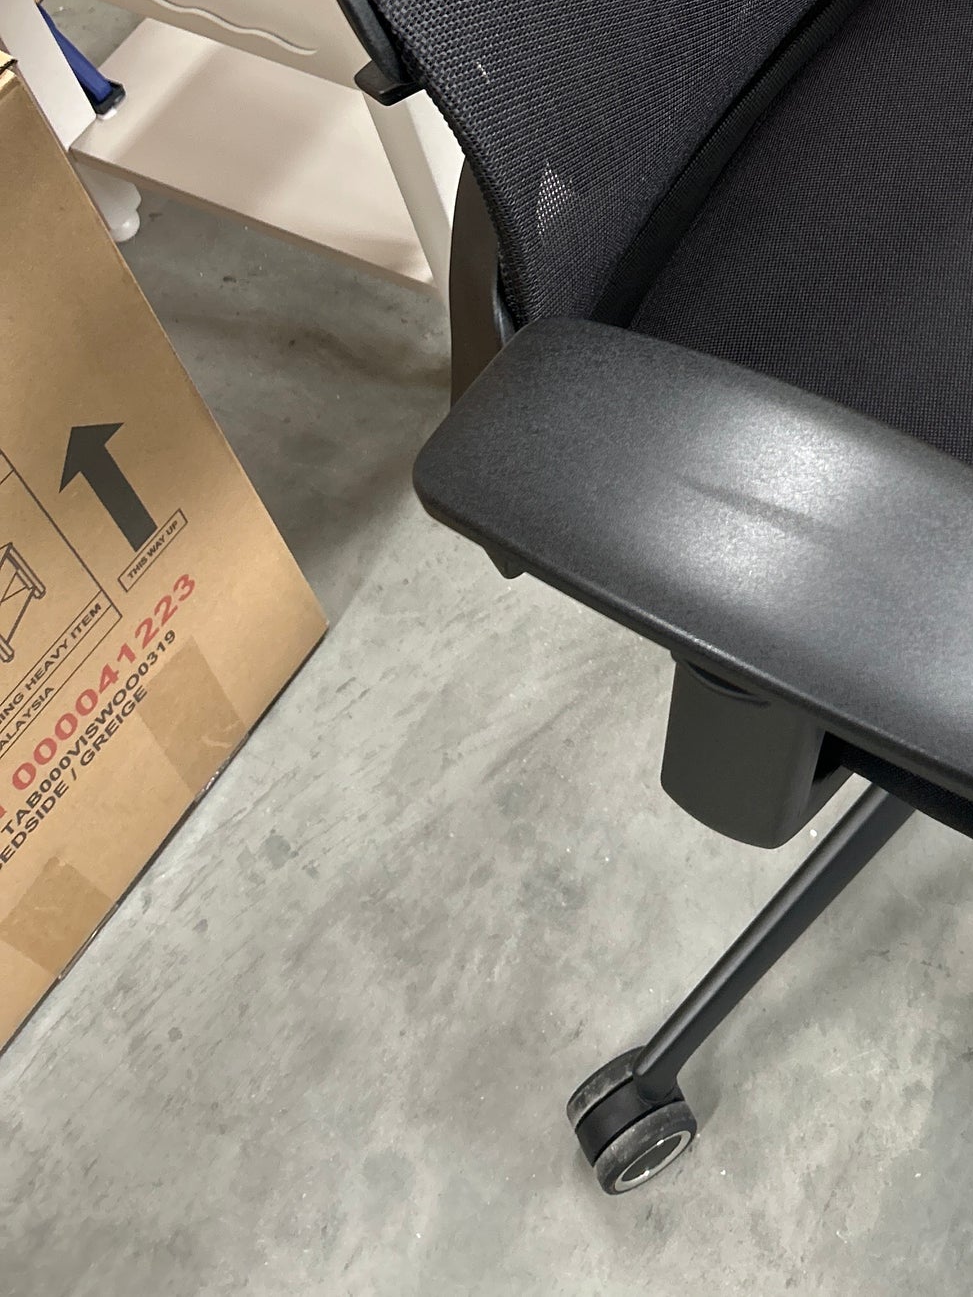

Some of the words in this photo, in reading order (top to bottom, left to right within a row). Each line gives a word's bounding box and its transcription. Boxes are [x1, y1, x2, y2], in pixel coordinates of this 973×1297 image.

[127, 556, 148, 579] THIS
[147, 535, 166, 557] WAY
[165, 520, 178, 535] UP
[0, 692, 25, 724] ING
[25, 638, 68, 691] HEAVY
[70, 603, 101, 640] ITEM
[12, 573, 195, 790] 000041223
[0, 780, 69, 870] EDSIDE
[80, 685, 148, 766] GREIGE
